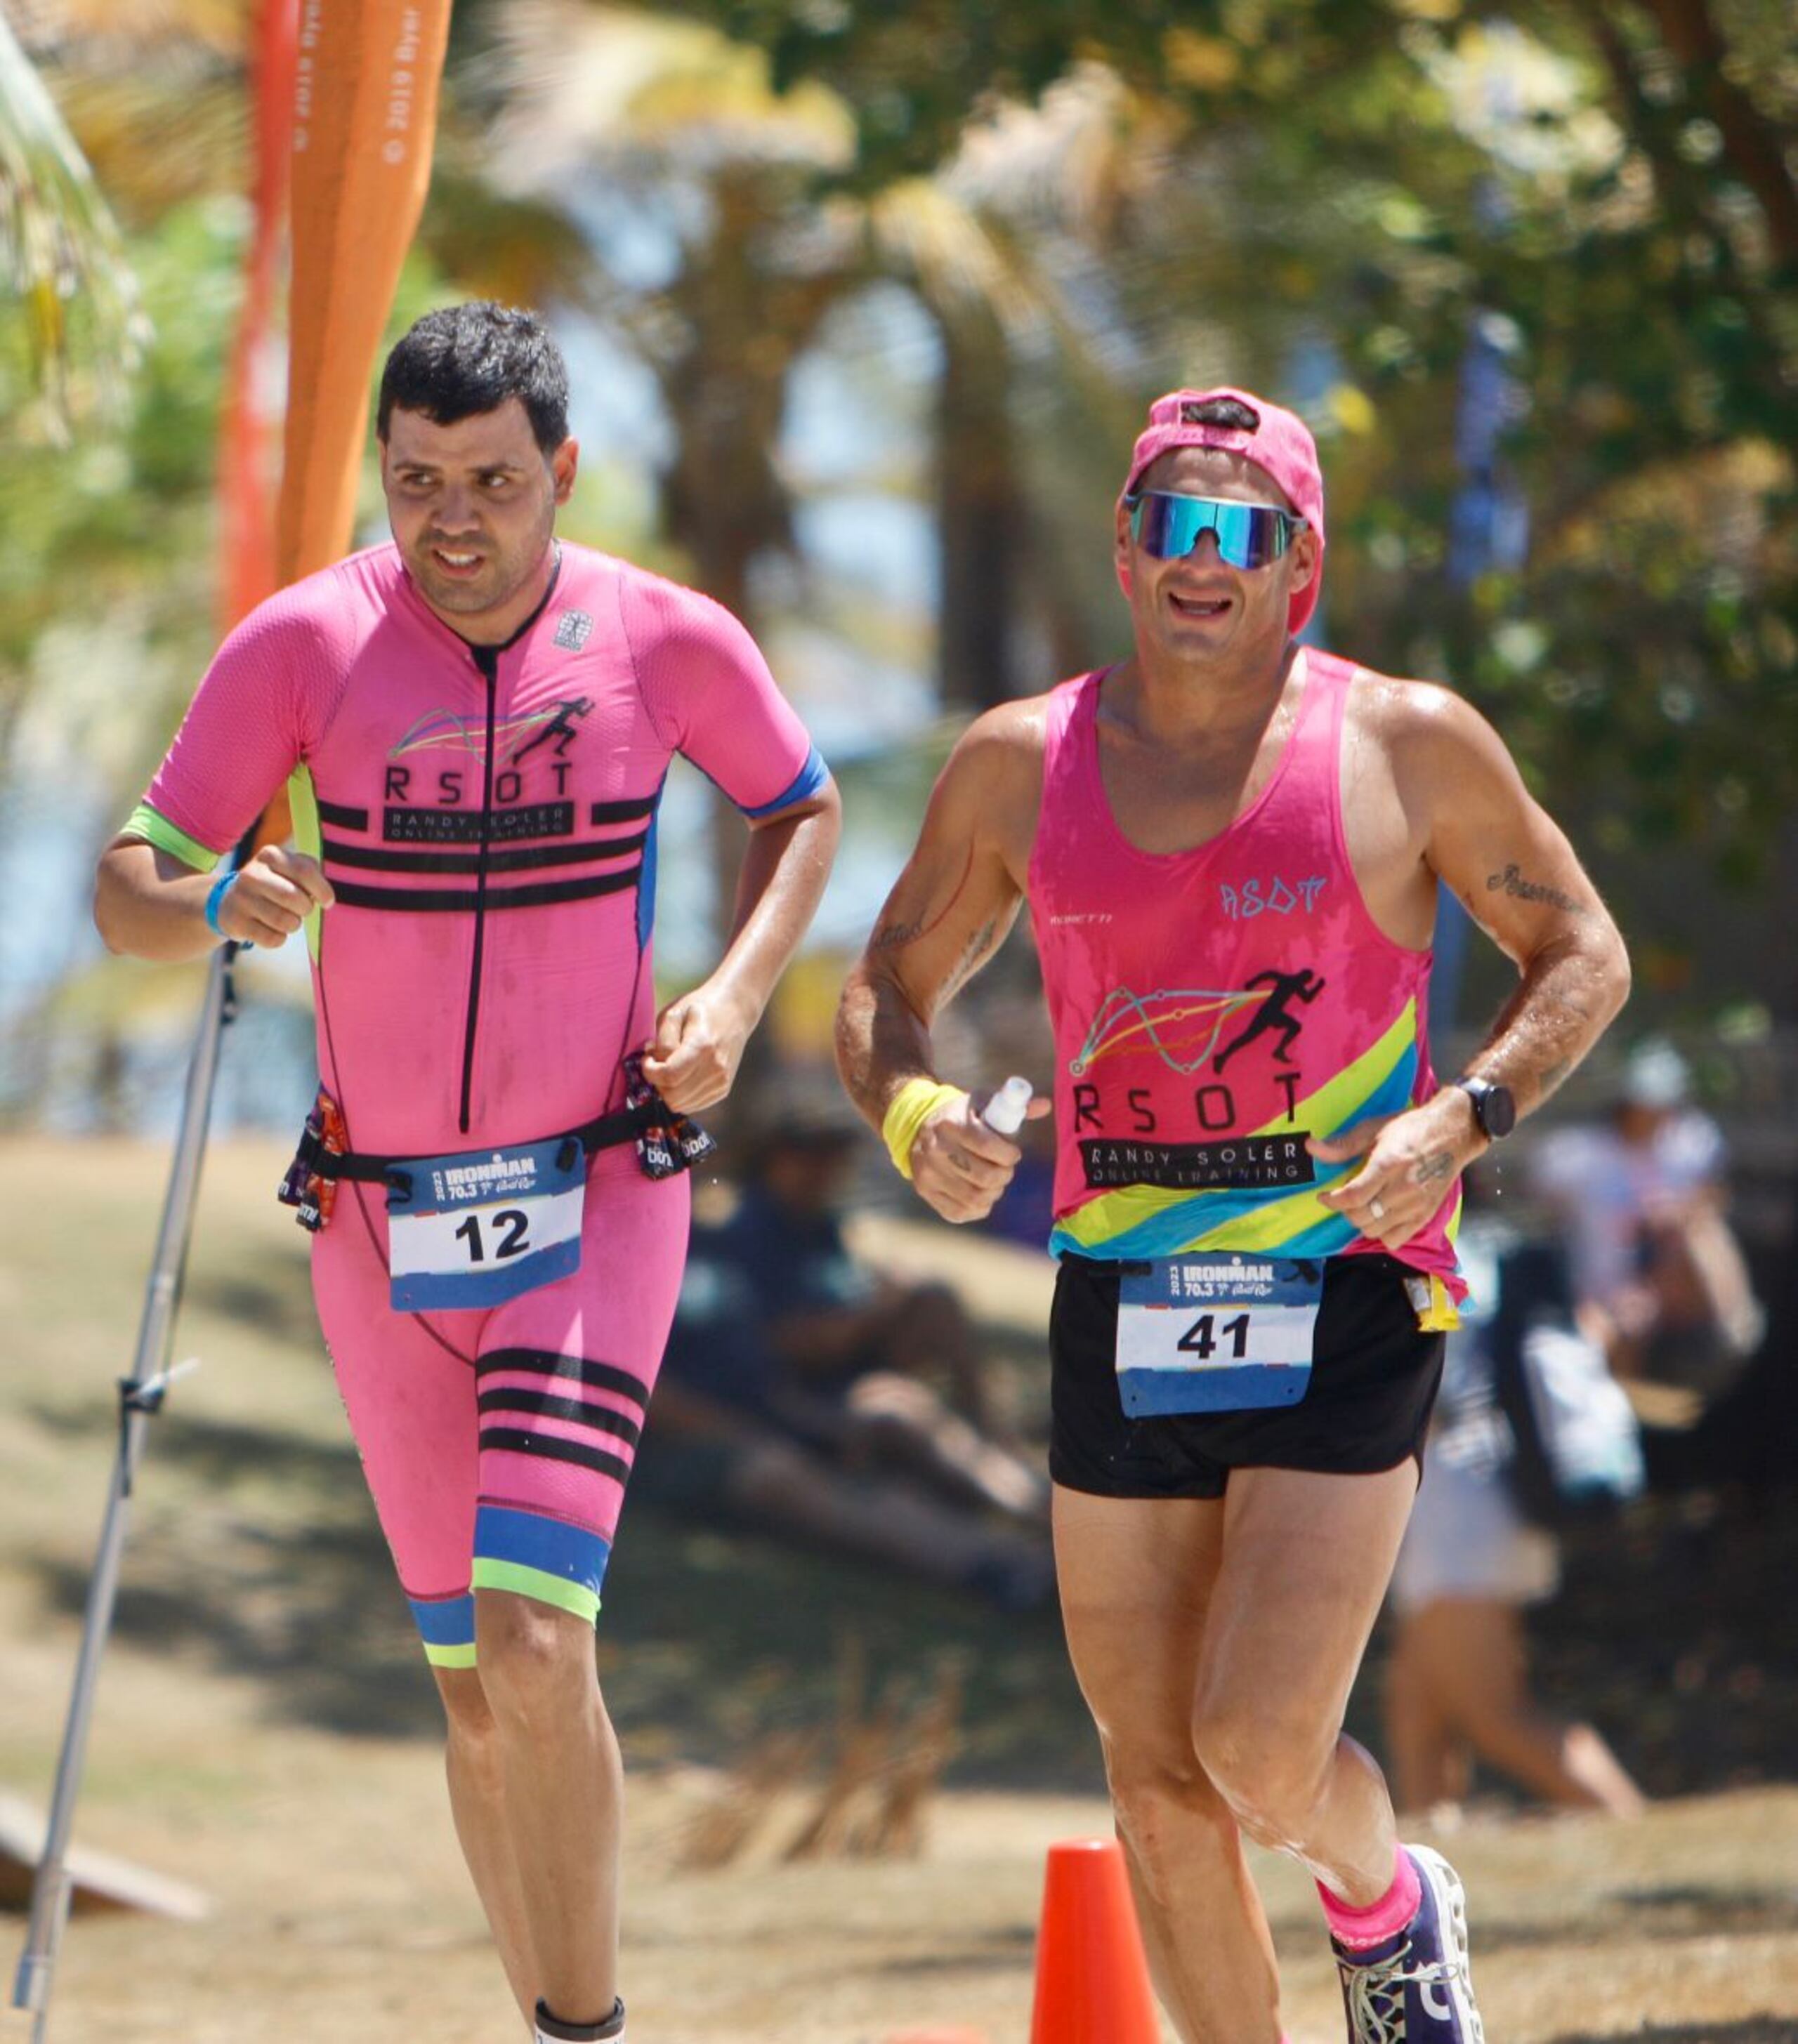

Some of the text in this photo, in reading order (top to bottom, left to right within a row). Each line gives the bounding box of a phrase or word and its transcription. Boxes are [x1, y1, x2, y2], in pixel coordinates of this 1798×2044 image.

[393, 812, 467, 828] RANDY
[1091, 1142, 1297, 1166] RANDY SOLER
[445, 1154, 537, 1186] IRONMAN
[447, 1182, 478, 1201] 70.3
[455, 1210, 531, 1262] 12
[1183, 1256, 1274, 1282] IRONMAN
[1183, 1282, 1214, 1297] 70.3
[1176, 1314, 1251, 1359] 41
